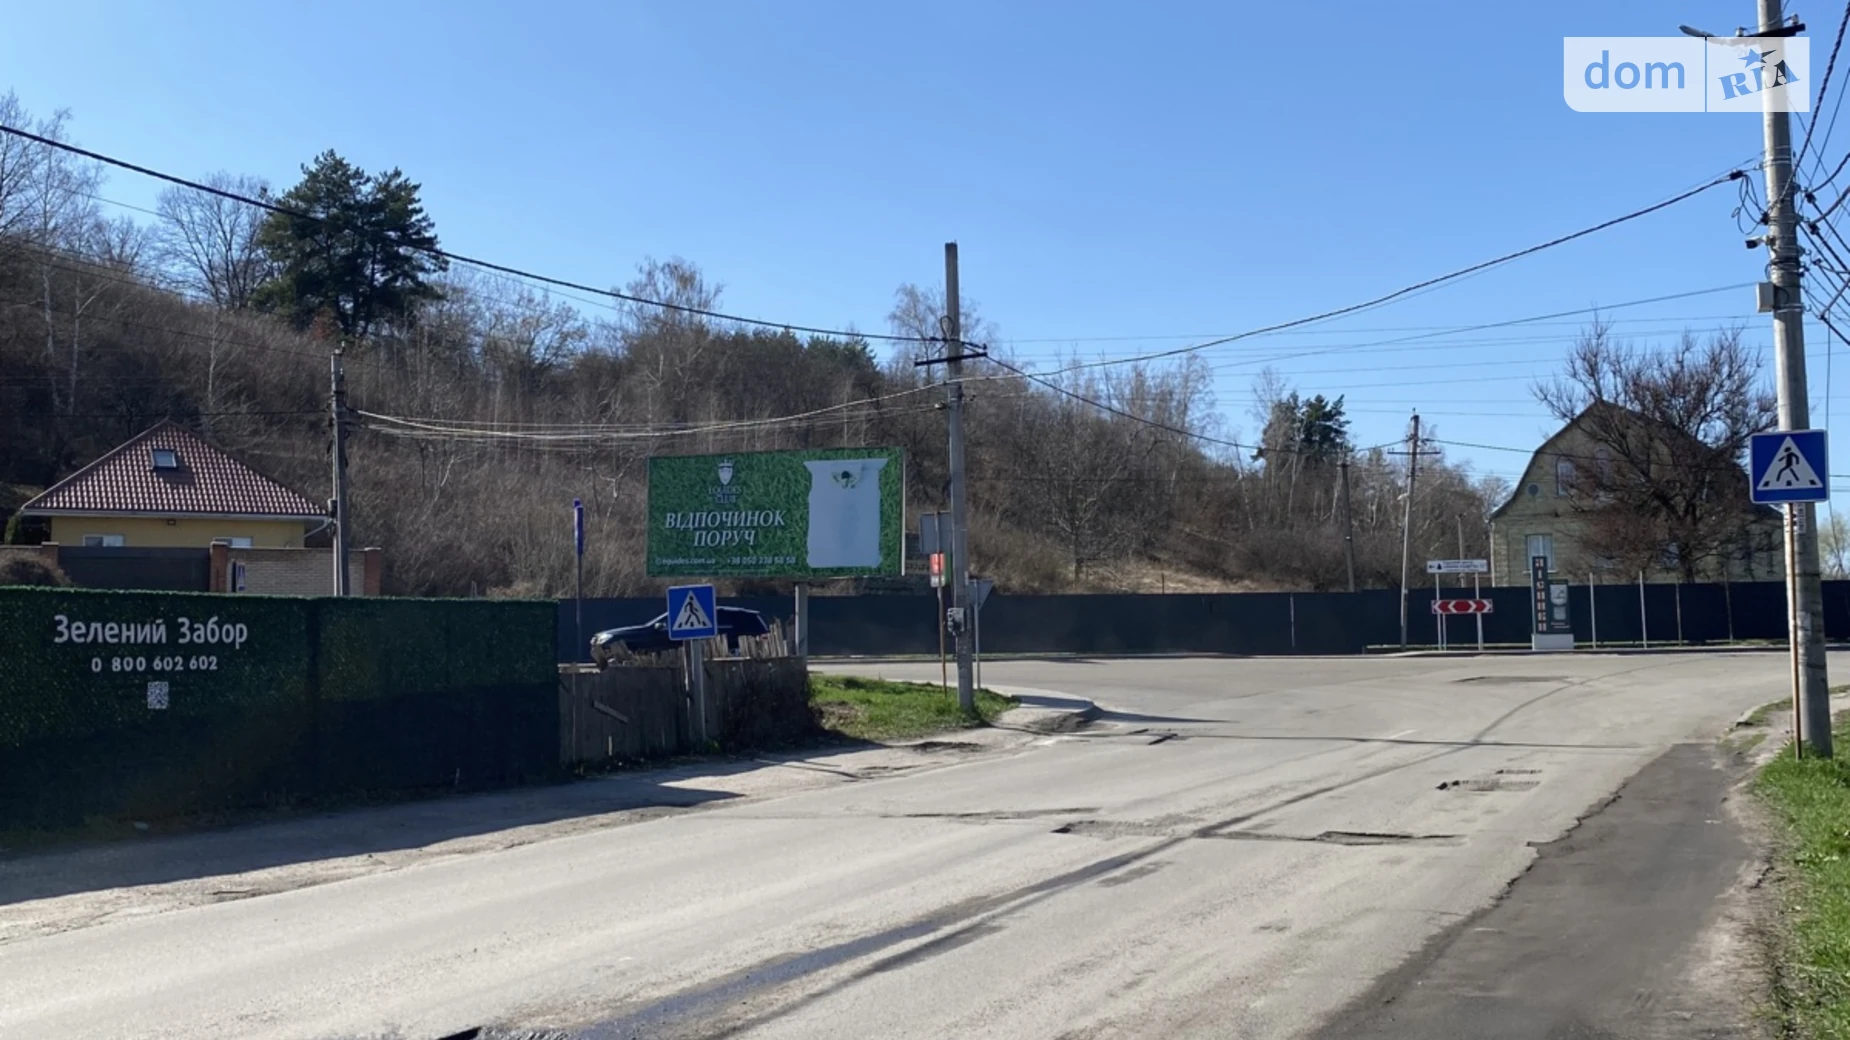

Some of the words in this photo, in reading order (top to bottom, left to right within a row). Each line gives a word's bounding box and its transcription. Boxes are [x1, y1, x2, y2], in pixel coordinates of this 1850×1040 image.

[665, 510, 786, 531] ВІДПОЧИНОК
[693, 530, 756, 547] ПОРУЧ
[54, 615, 166, 644] Зелений
[177, 616, 248, 649] Забор
[91, 657, 102, 672] 0
[112, 657, 146, 672] 800
[153, 656, 184, 671] 602
[189, 656, 218, 671] 602
